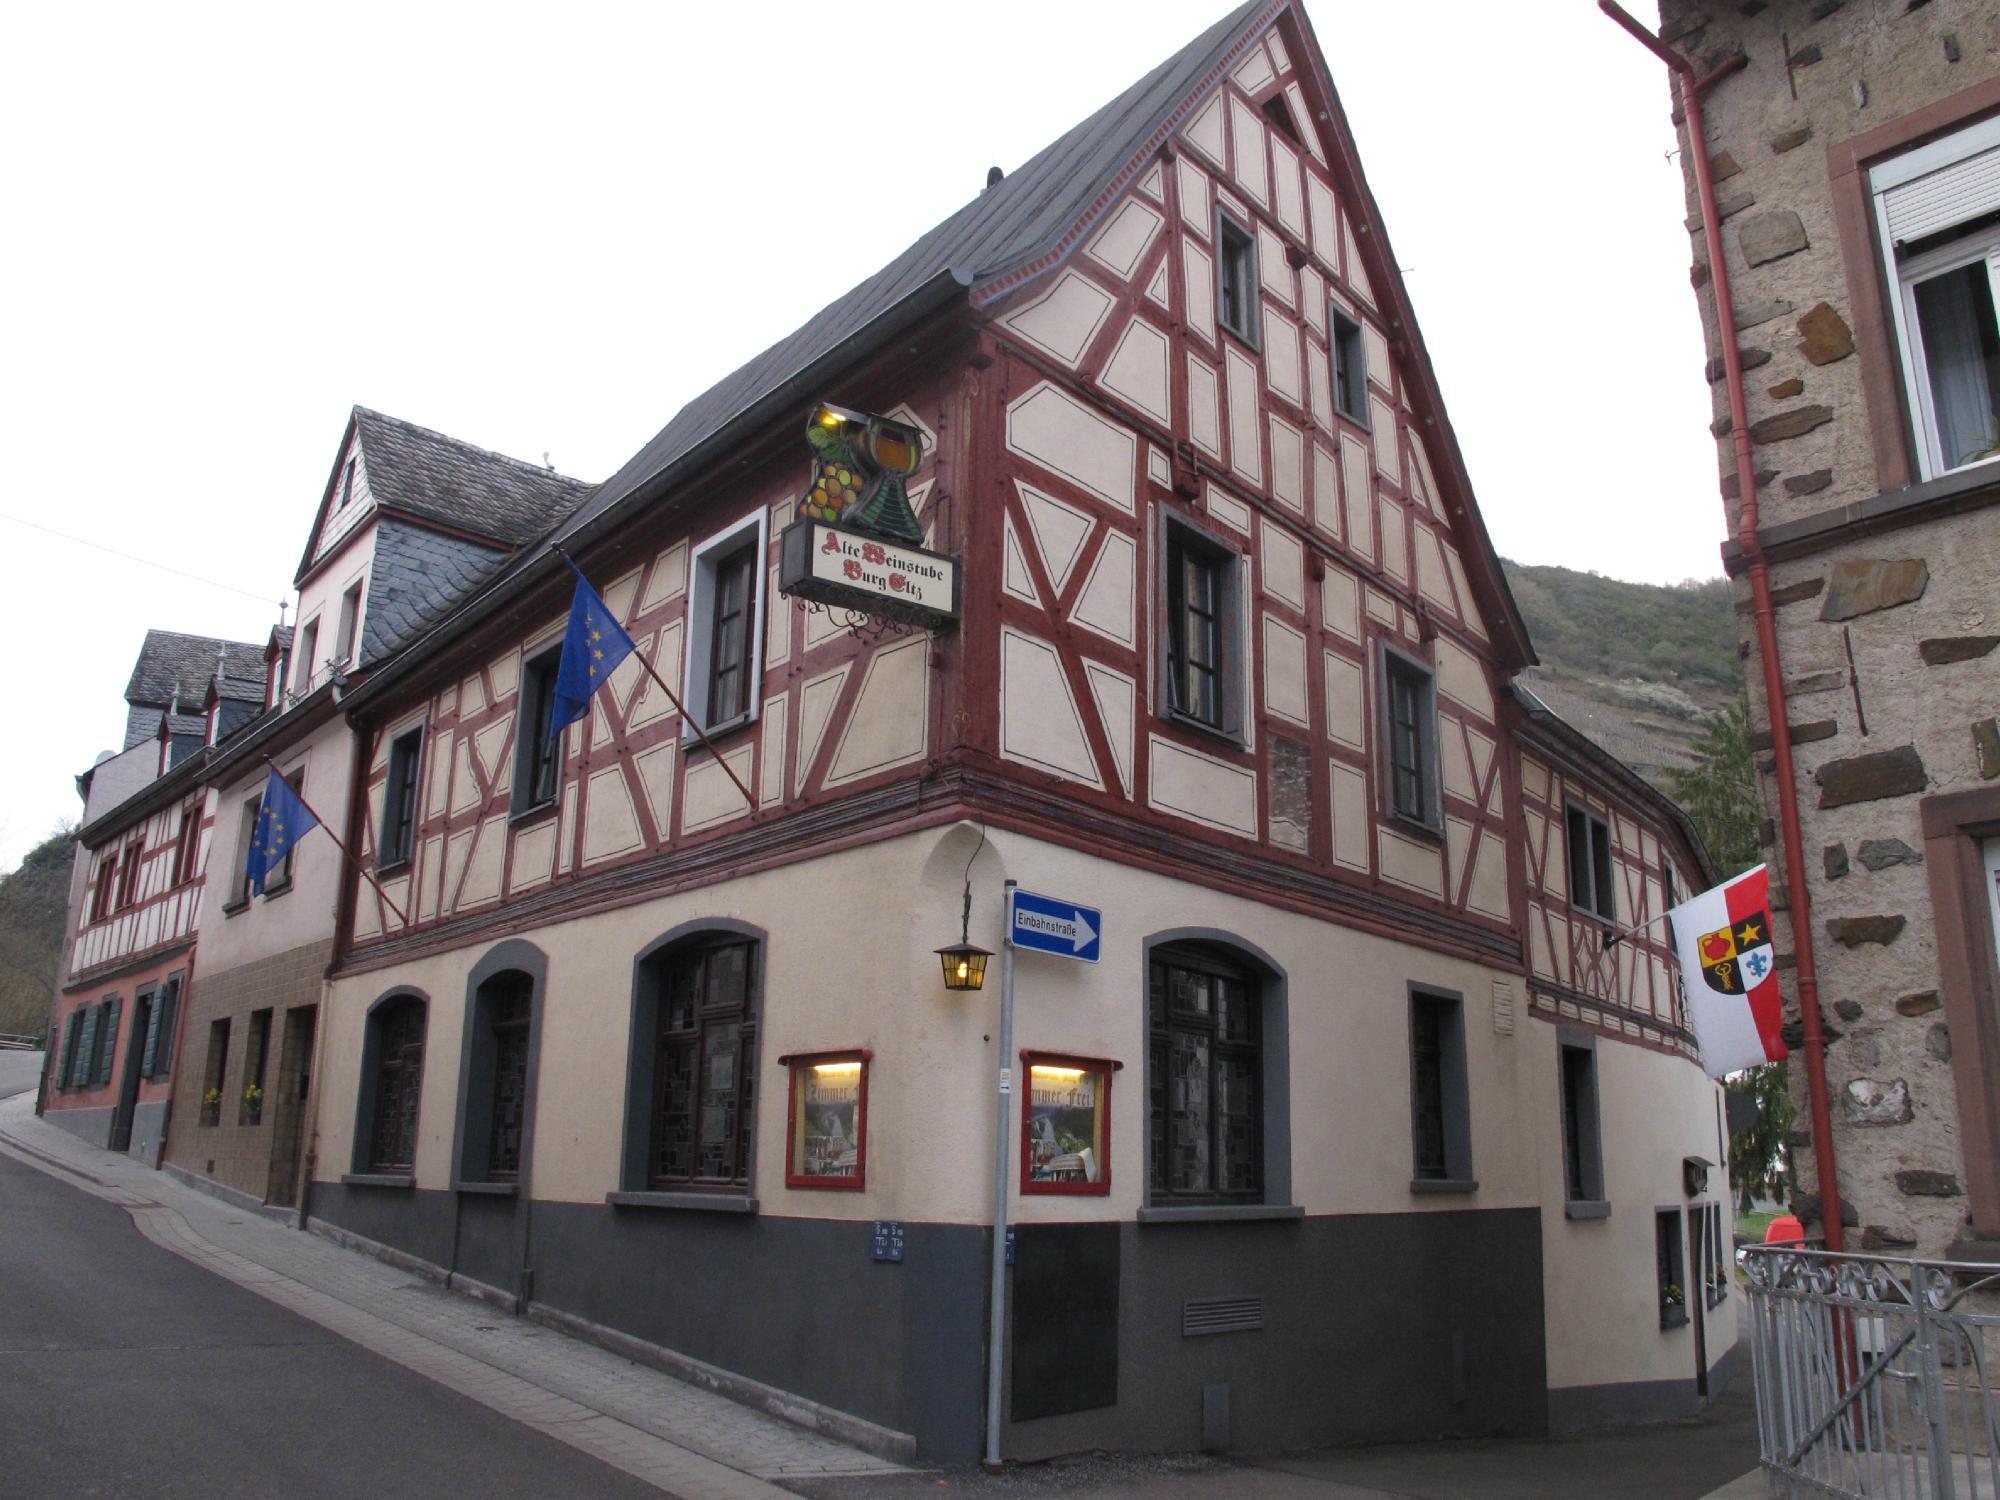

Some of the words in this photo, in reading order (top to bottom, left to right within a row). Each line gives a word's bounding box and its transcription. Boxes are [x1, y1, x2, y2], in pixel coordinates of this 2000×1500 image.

[821, 531, 860, 557] Alte
[862, 542, 944, 581] Weinstube
[843, 559, 887, 591] Burg
[889, 572, 923, 601] Eltz
[1018, 912, 1077, 936] Einbahnstraße
